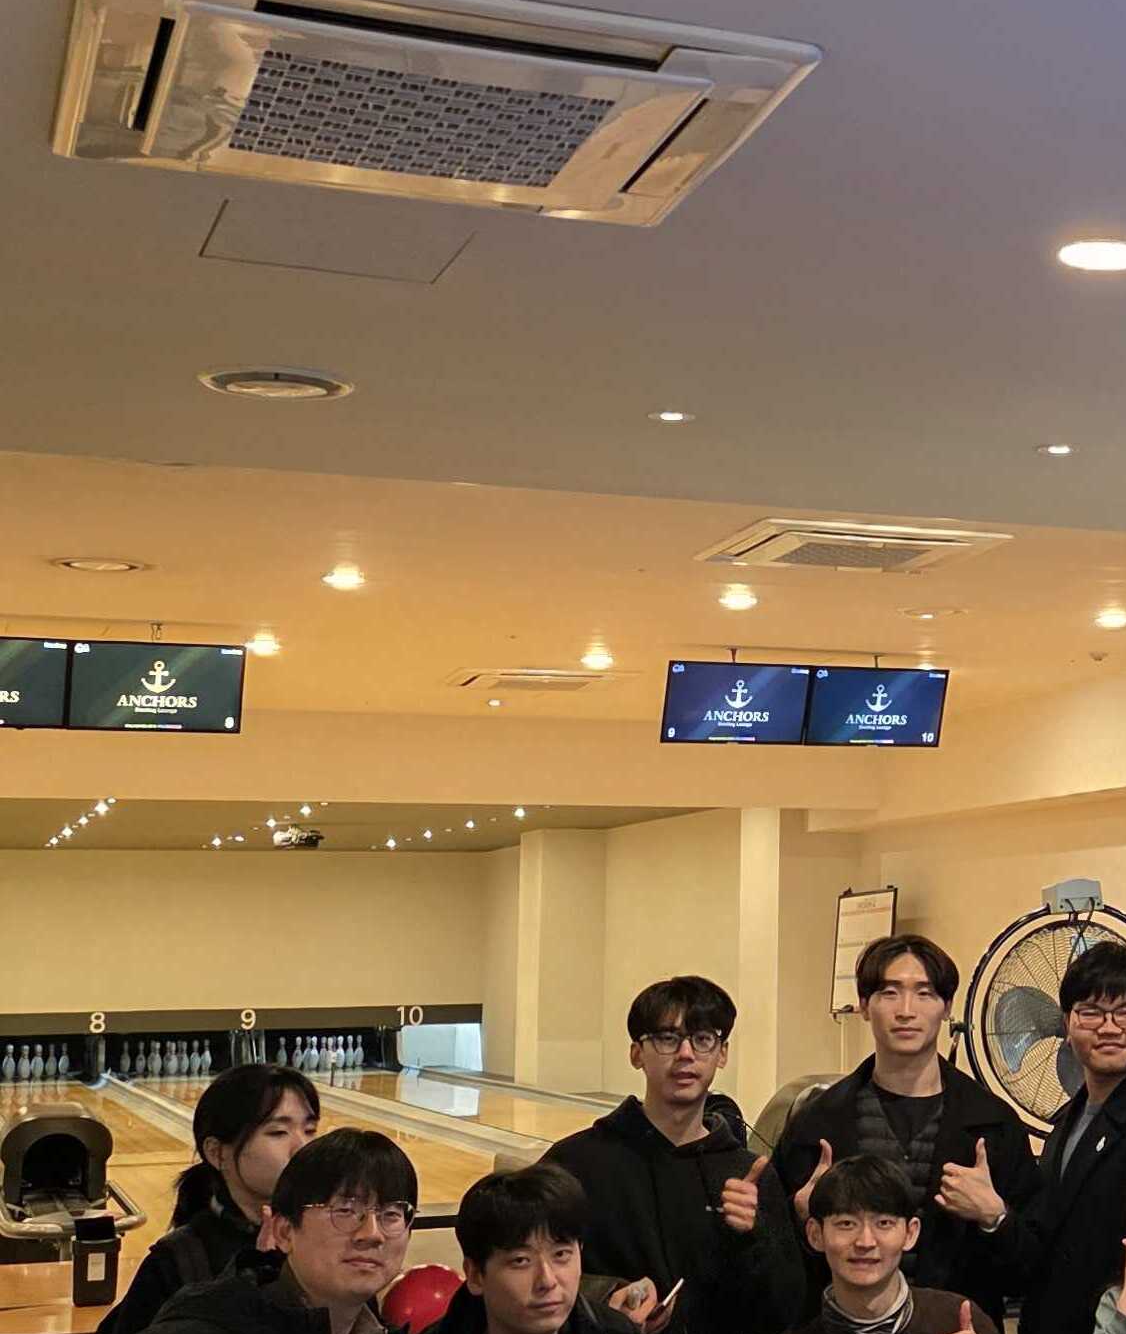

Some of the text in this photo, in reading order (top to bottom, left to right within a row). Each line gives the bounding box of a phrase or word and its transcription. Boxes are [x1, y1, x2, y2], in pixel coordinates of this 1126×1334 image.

[117, 695, 198, 708] ANCHORS
[703, 710, 770, 722] ANCHORS
[845, 714, 908, 725] ANCHORS
[667, 727, 676, 738] 9
[921, 732, 935, 743] 10
[240, 1009, 257, 1030] 9
[396, 1005, 424, 1027] 10
[88, 1011, 106, 1034] 8
